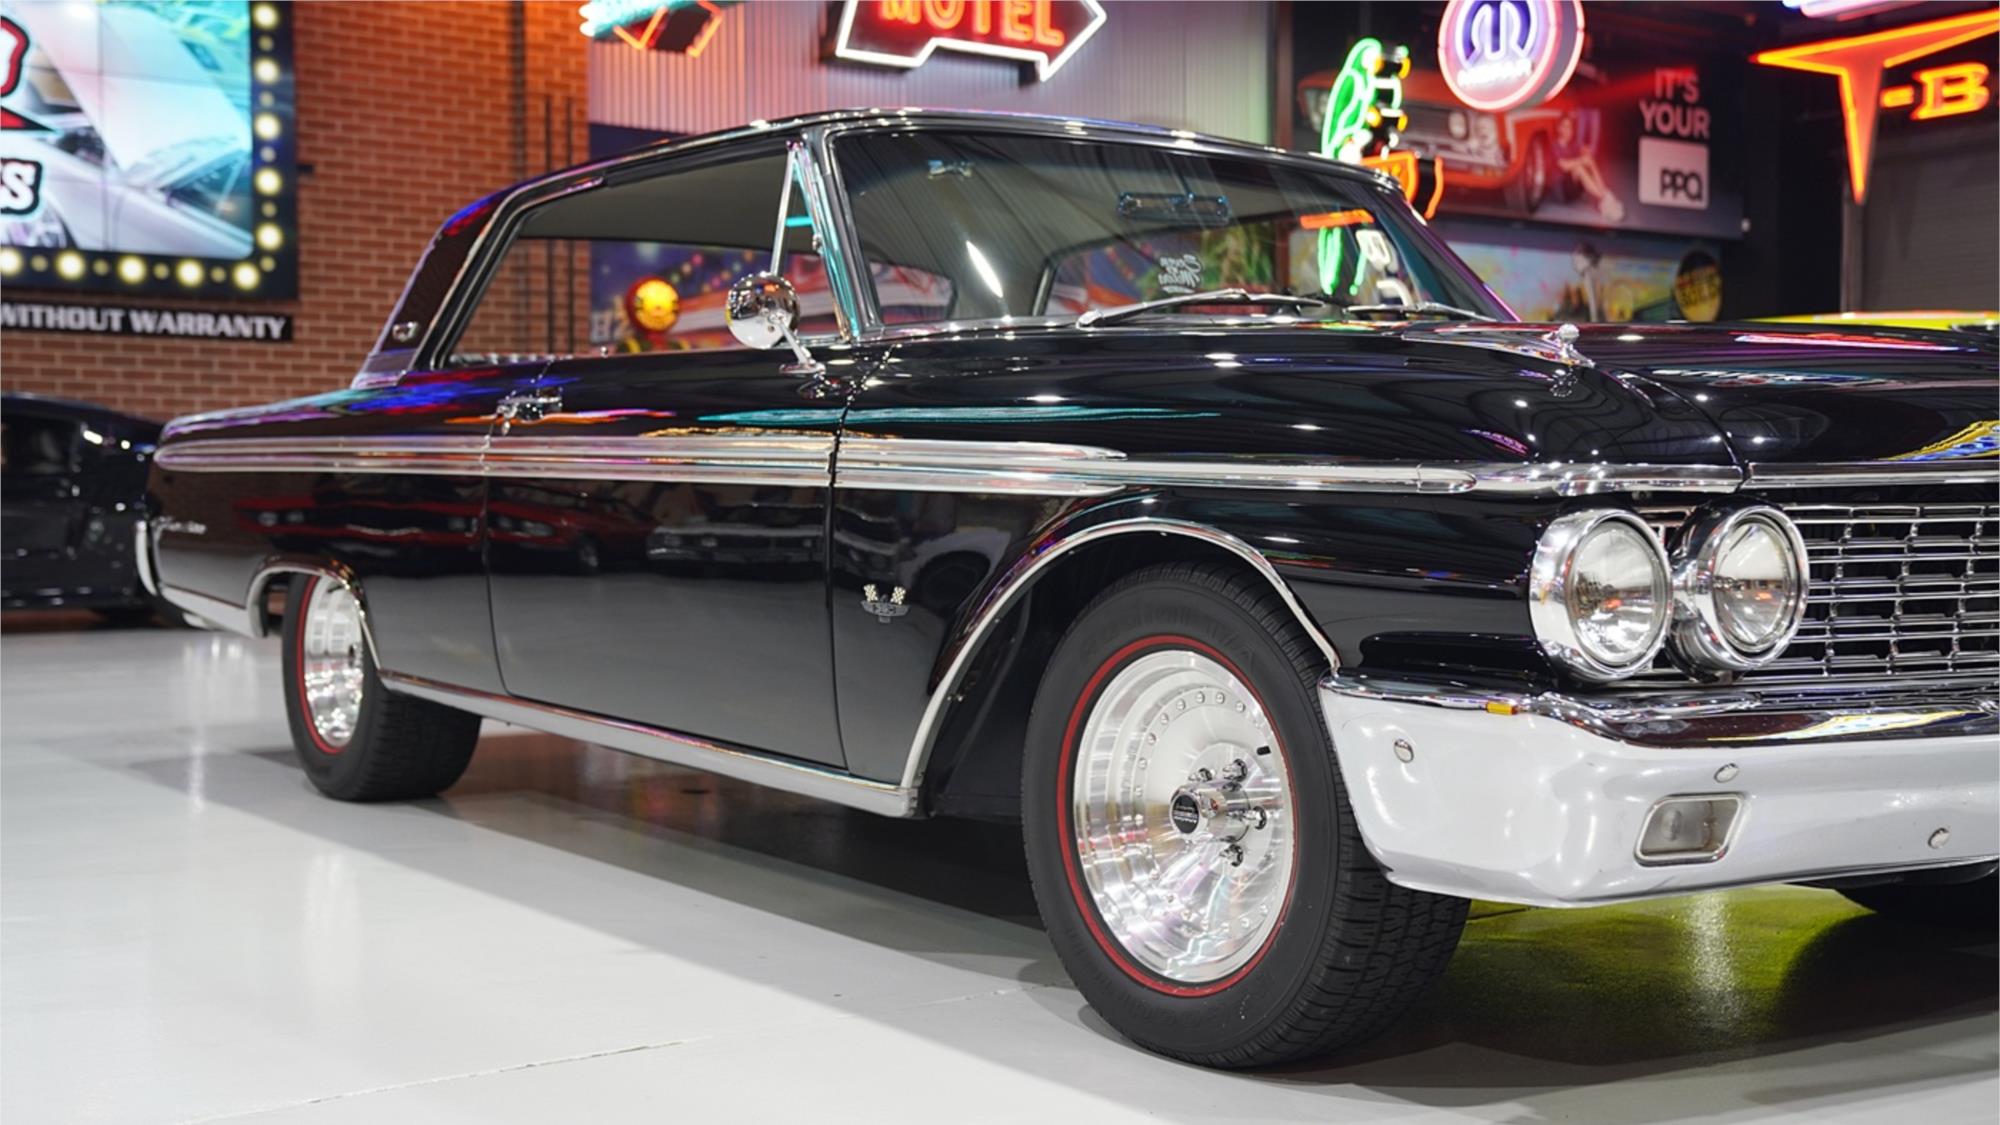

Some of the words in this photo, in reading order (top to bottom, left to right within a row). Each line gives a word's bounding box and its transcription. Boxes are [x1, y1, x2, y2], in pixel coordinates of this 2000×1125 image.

[1654, 68, 1700, 104] IT'S
[1639, 100, 1710, 139] YOUR
[1660, 167, 1703, 201] PPQ
[129, 310, 287, 339] WARRANTY
